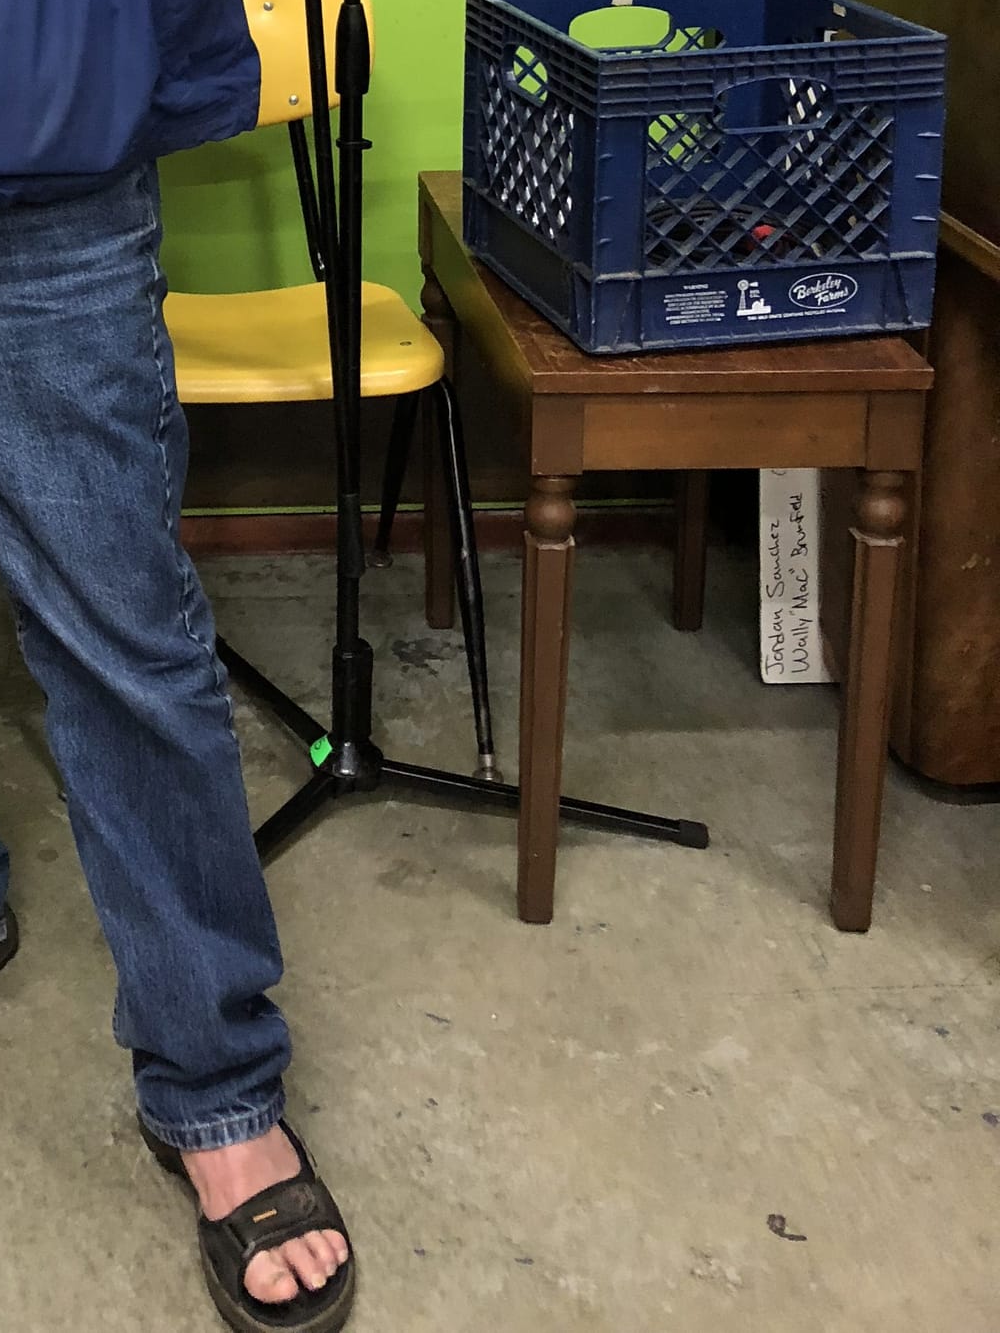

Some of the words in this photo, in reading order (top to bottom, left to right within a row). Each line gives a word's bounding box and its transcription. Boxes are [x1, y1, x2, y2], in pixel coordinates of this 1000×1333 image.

[792, 275, 842, 300] Berkeley
[814, 286, 849, 306] Farms
[766, 519, 785, 598] Sanchez
[765, 609, 784, 675] Jordan
[791, 618, 813, 673] Wally
